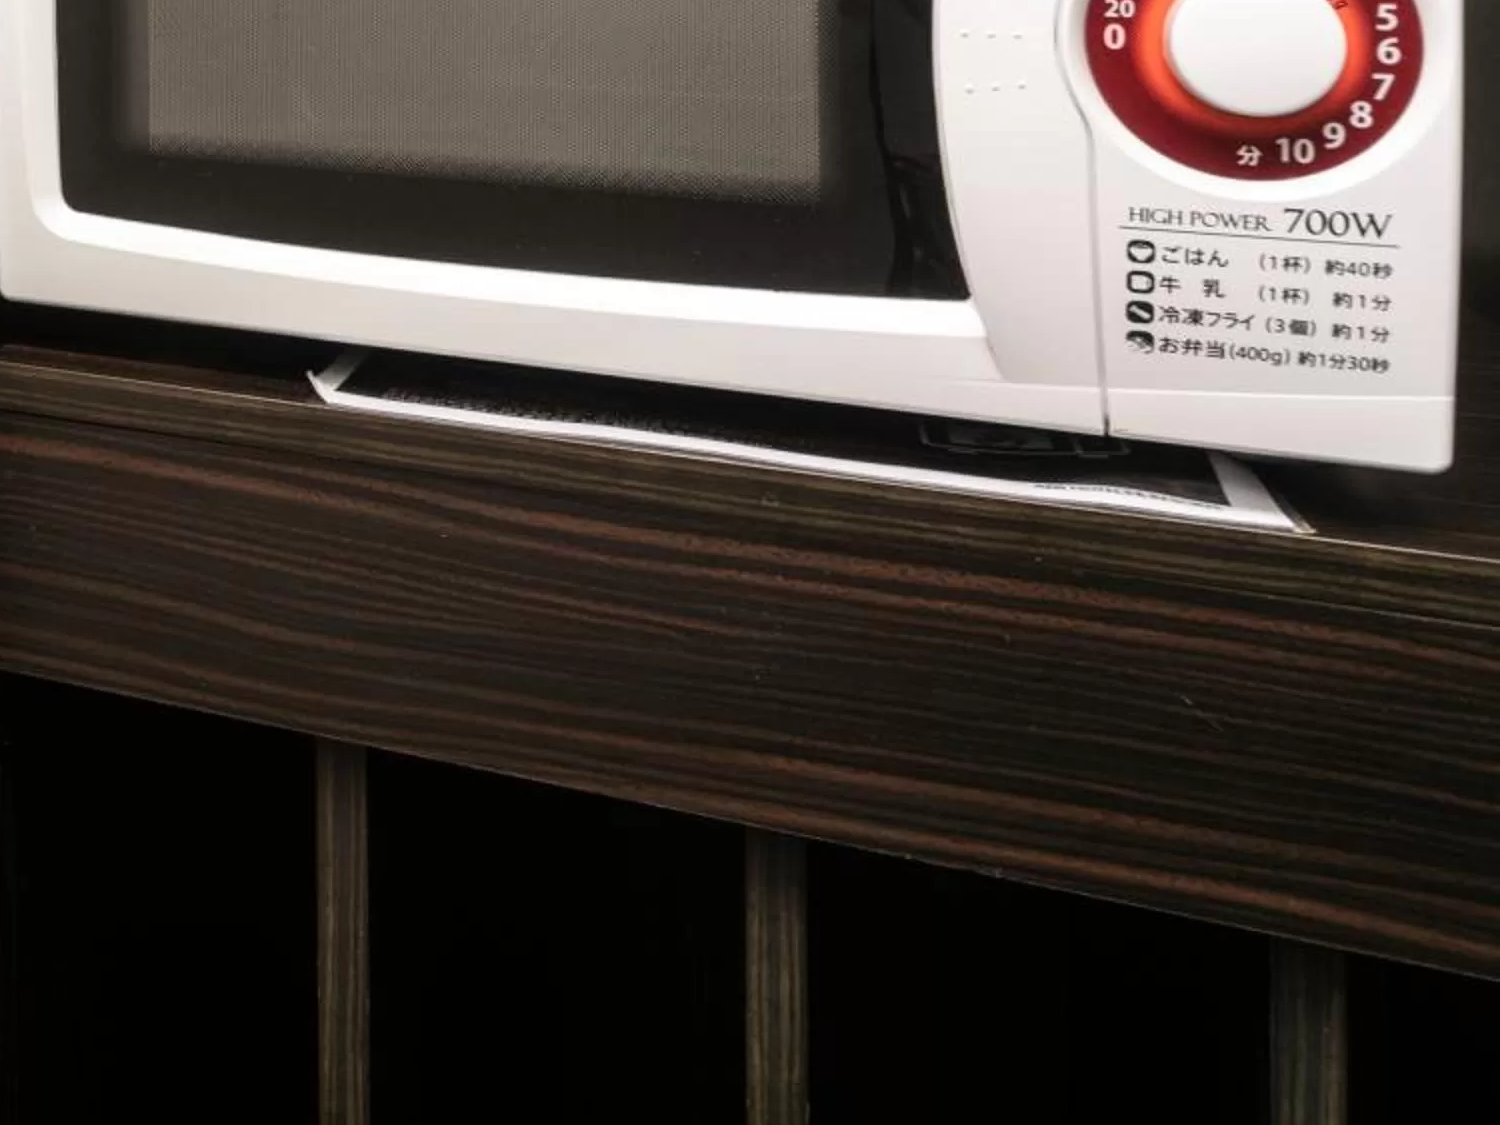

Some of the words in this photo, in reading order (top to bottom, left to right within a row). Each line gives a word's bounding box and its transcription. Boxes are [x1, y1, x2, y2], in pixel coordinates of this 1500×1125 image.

[1375, 3, 1399, 32] 5
[1103, 24, 1126, 50] 0
[1376, 37, 1402, 65] 6
[1371, 72, 1395, 101] 7
[1349, 100, 1374, 129] 8
[1322, 121, 1346, 149] 9
[1275, 137, 1316, 164] 10
[1128, 206, 1183, 226] HIGH
[1189, 209, 1273, 232] POWER
[1283, 207, 1393, 240] 700W
[1161, 245, 1230, 268] ごはん
[1324, 259, 1394, 279] 約40秒
[1158, 305, 1256, 331] 冷凍フライ
